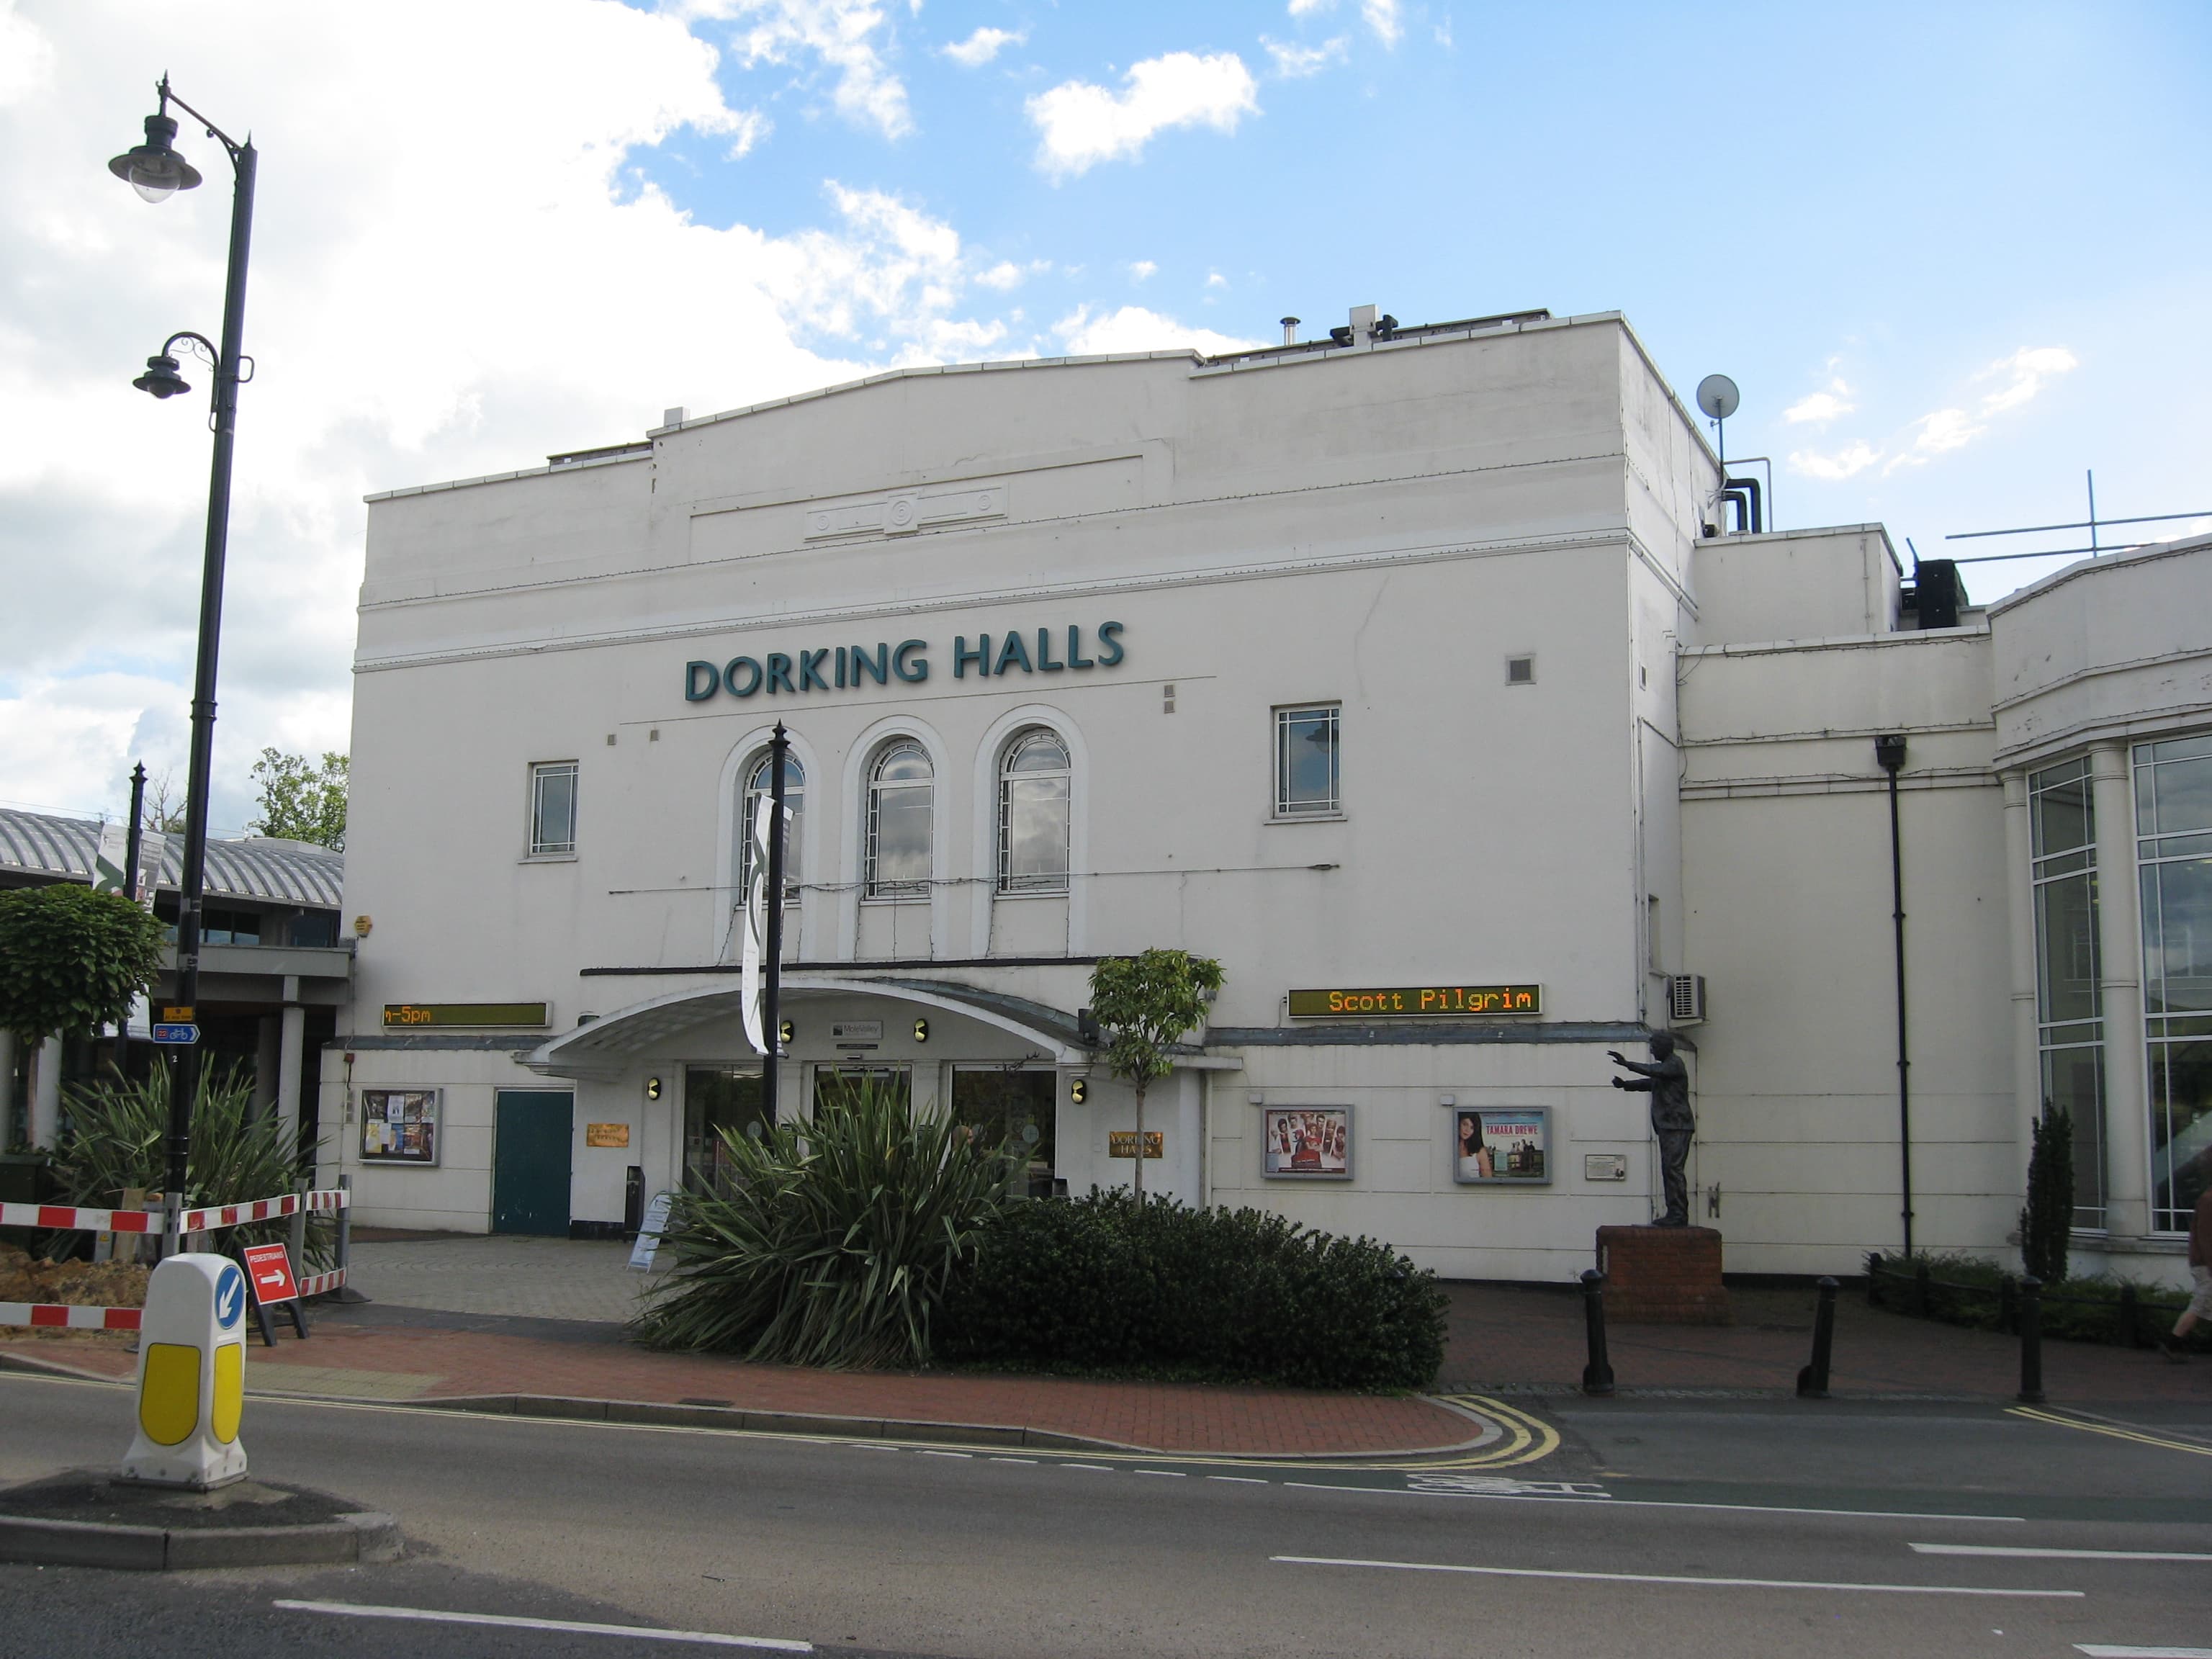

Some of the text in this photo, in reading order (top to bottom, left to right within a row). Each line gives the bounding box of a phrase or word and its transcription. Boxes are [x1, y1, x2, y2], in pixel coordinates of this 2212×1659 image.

[685, 621, 1124, 701] DORKING HALLS
[1329, 987, 1532, 1012] Scott Pilgrim
[1485, 1125, 1513, 1135] TAMARA
[1121, 1145, 1151, 1154] HAS
[249, 1251, 284, 1263] PEDESTRIANS
